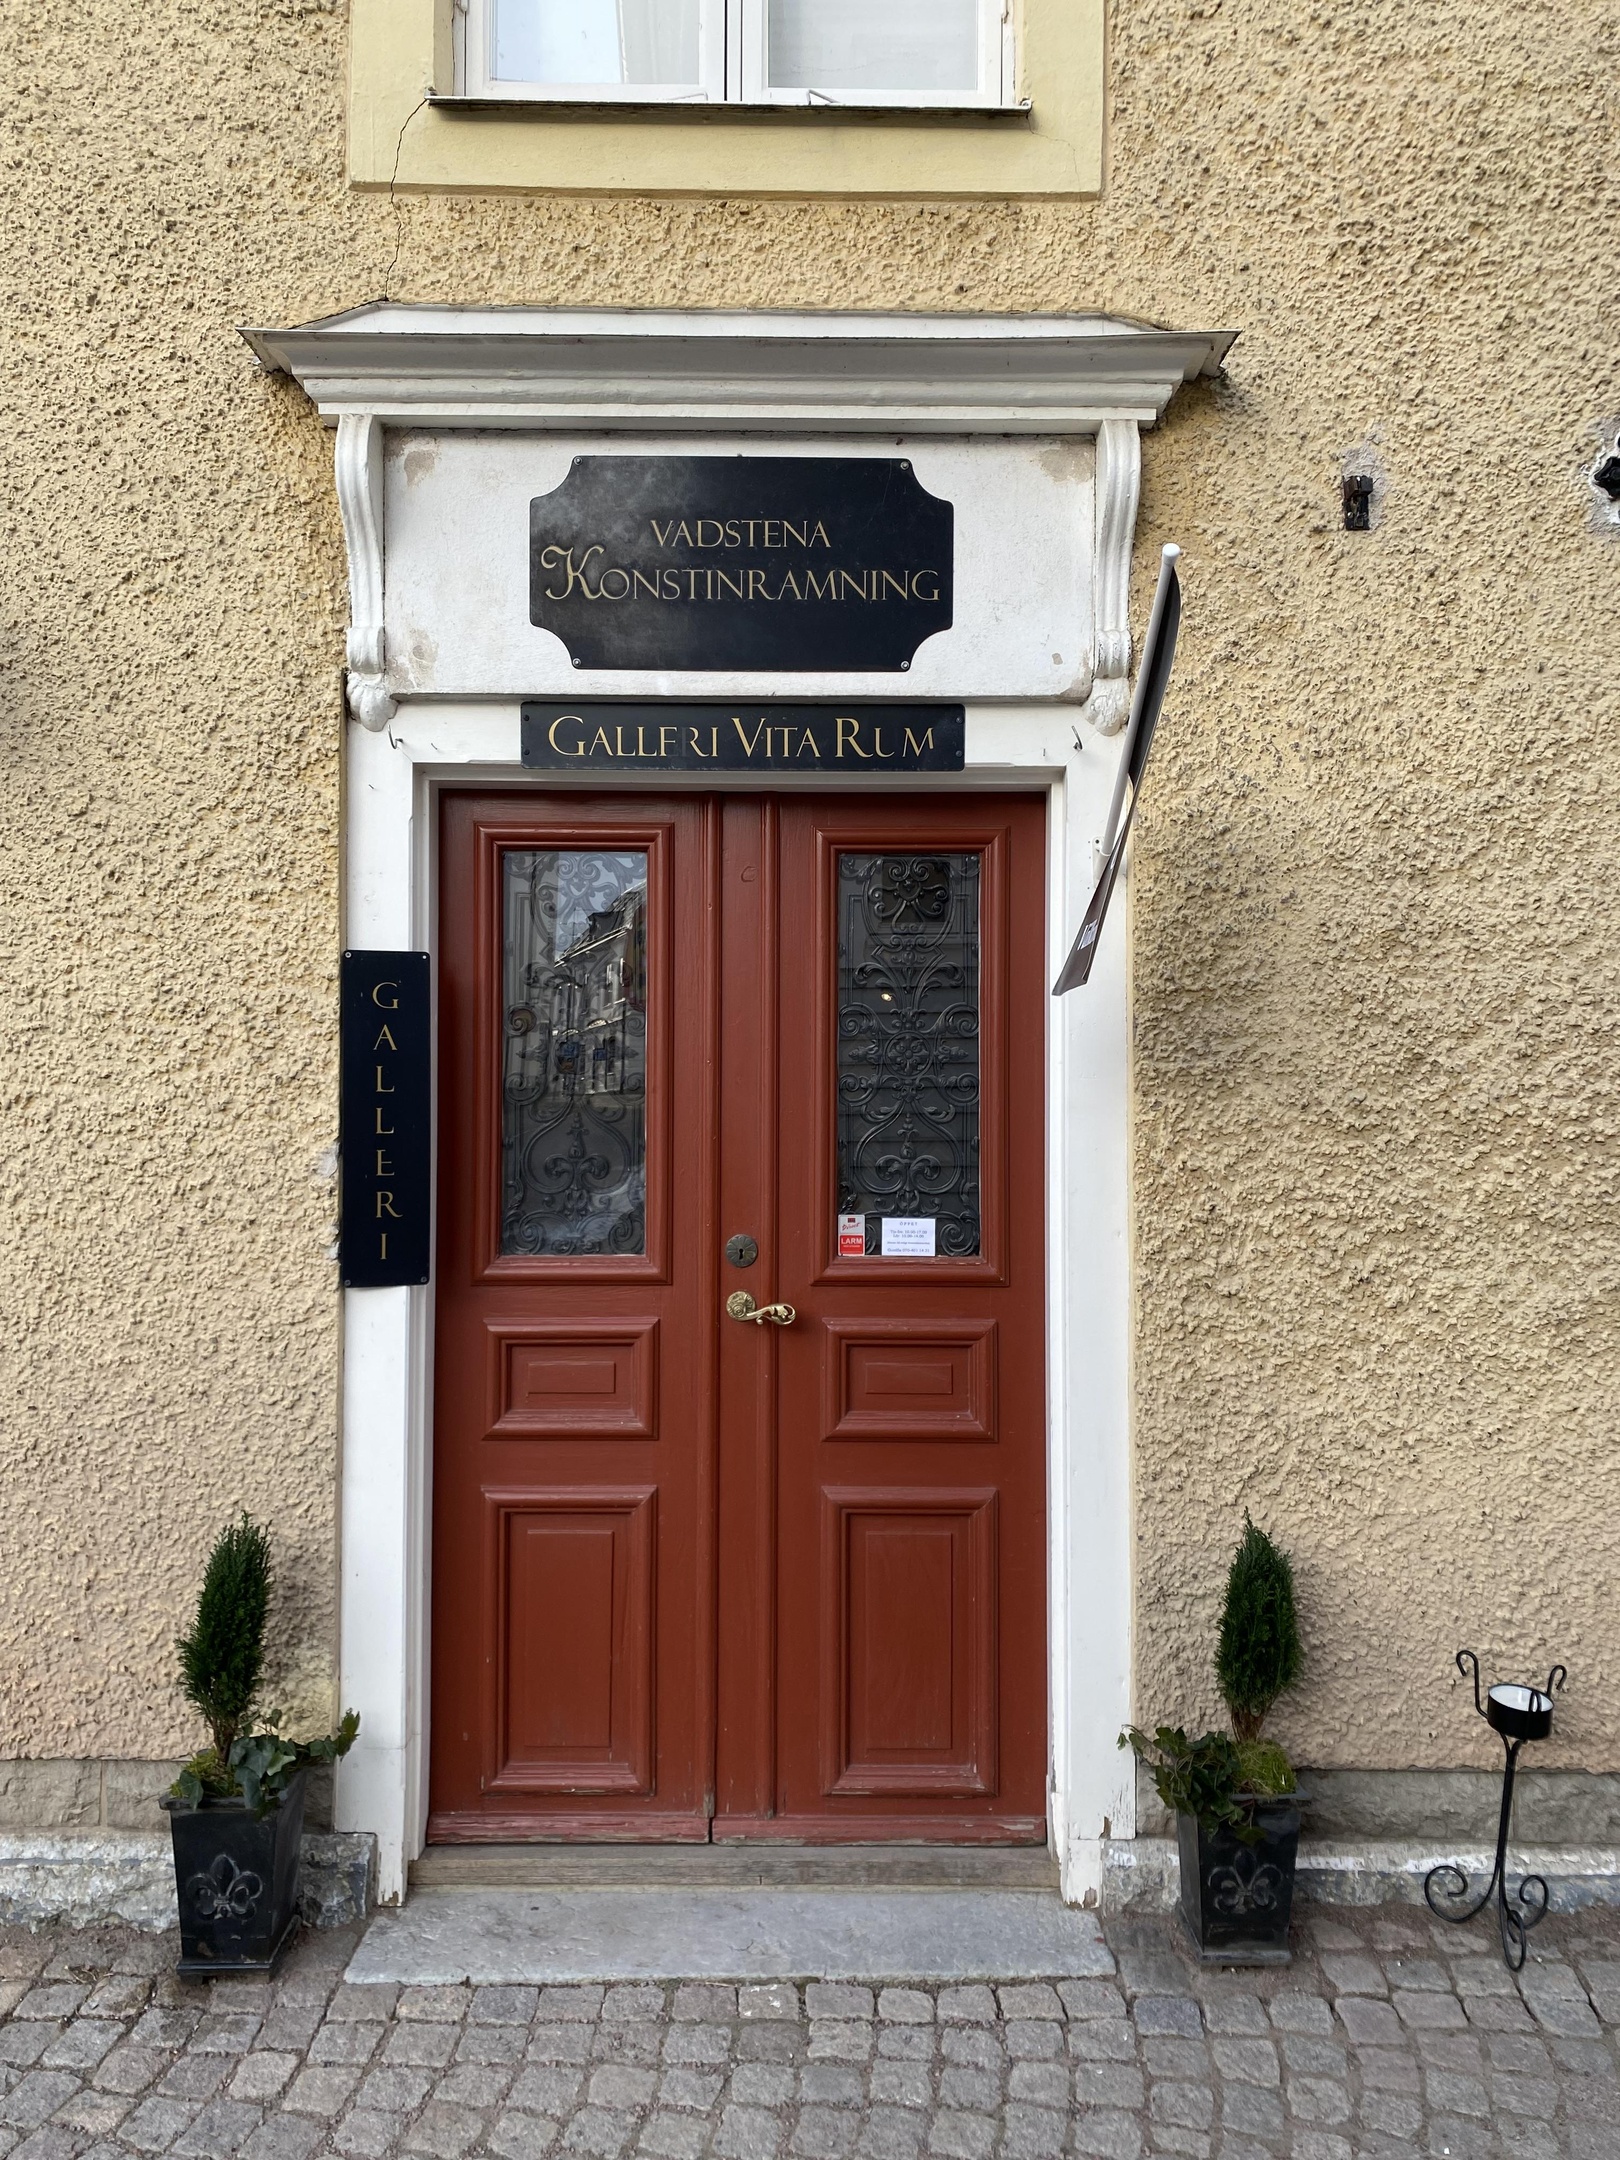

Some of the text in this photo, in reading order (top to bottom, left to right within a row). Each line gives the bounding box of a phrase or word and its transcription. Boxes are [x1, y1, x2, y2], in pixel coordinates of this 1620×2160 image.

[650, 519, 832, 548] VADSTENA
[731, 716, 822, 759] VITA
[834, 717, 935, 759] RUM
[372, 981, 403, 1260] GALLERI
